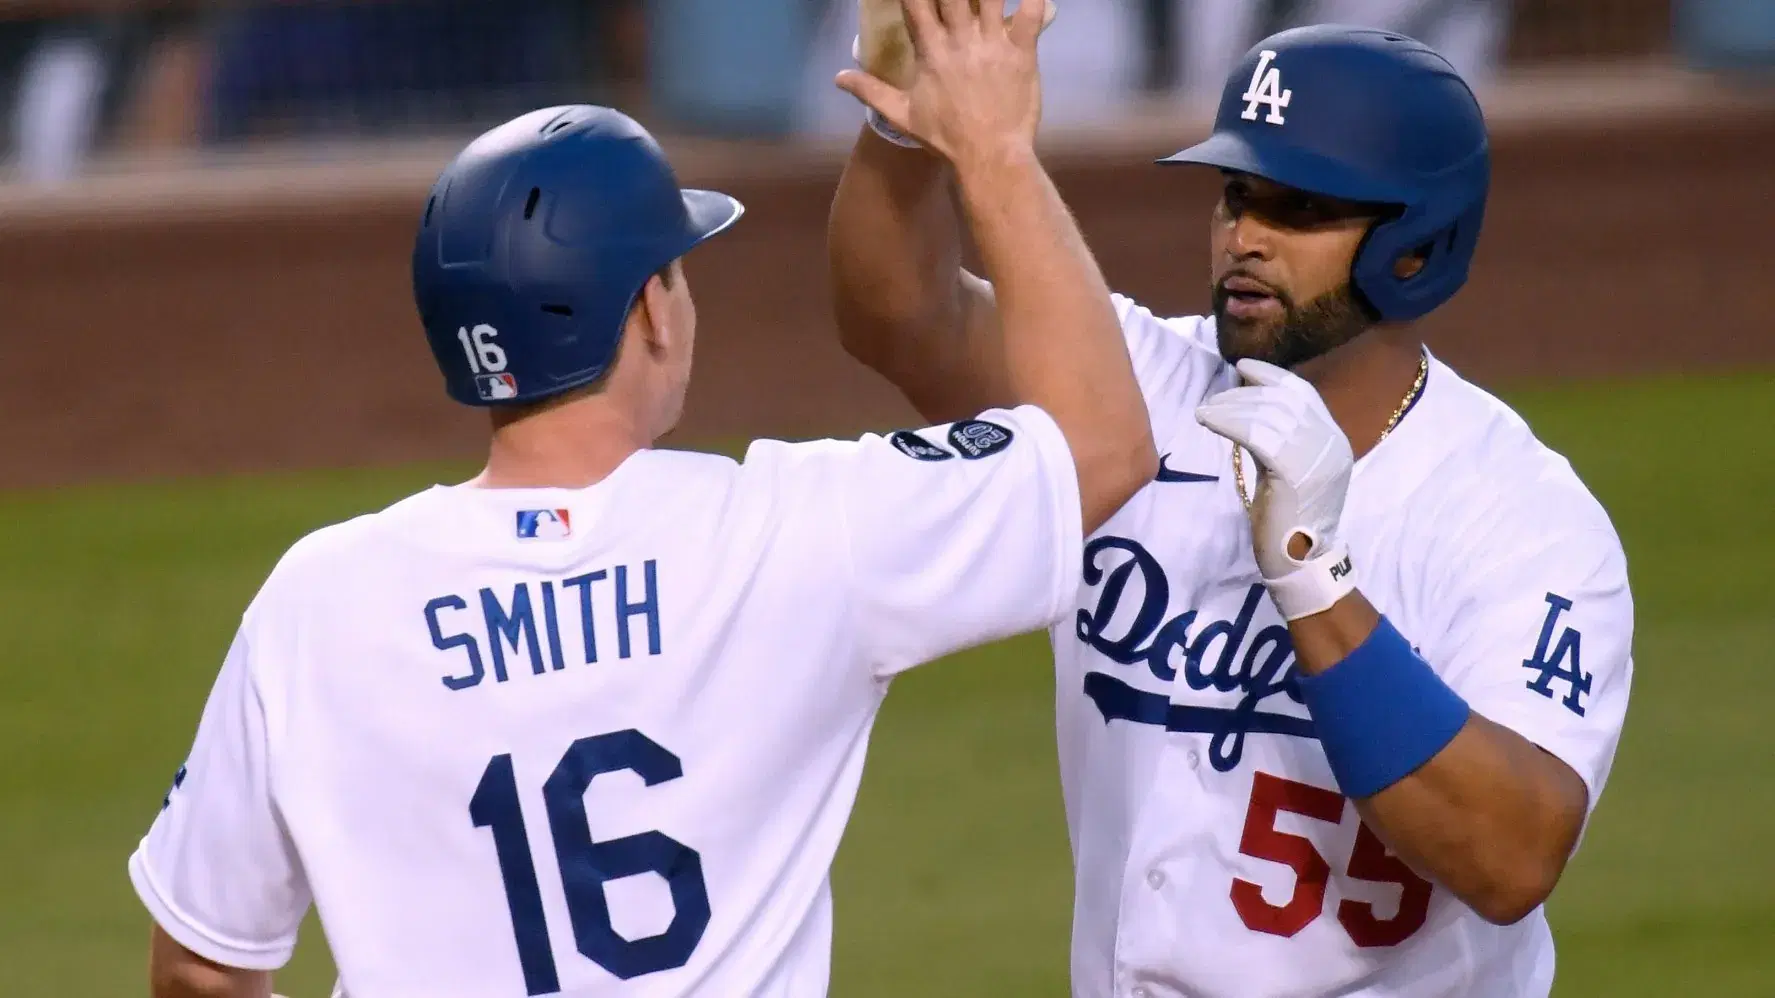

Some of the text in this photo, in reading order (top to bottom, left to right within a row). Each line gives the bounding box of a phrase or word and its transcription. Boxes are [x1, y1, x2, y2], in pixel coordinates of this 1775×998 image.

[1241, 50, 1292, 125] LA
[458, 323, 508, 373] 16
[424, 559, 661, 691] SMITH
[1522, 591, 1593, 718] LA
[469, 728, 712, 996] 16
[1229, 770, 1434, 948] 55
